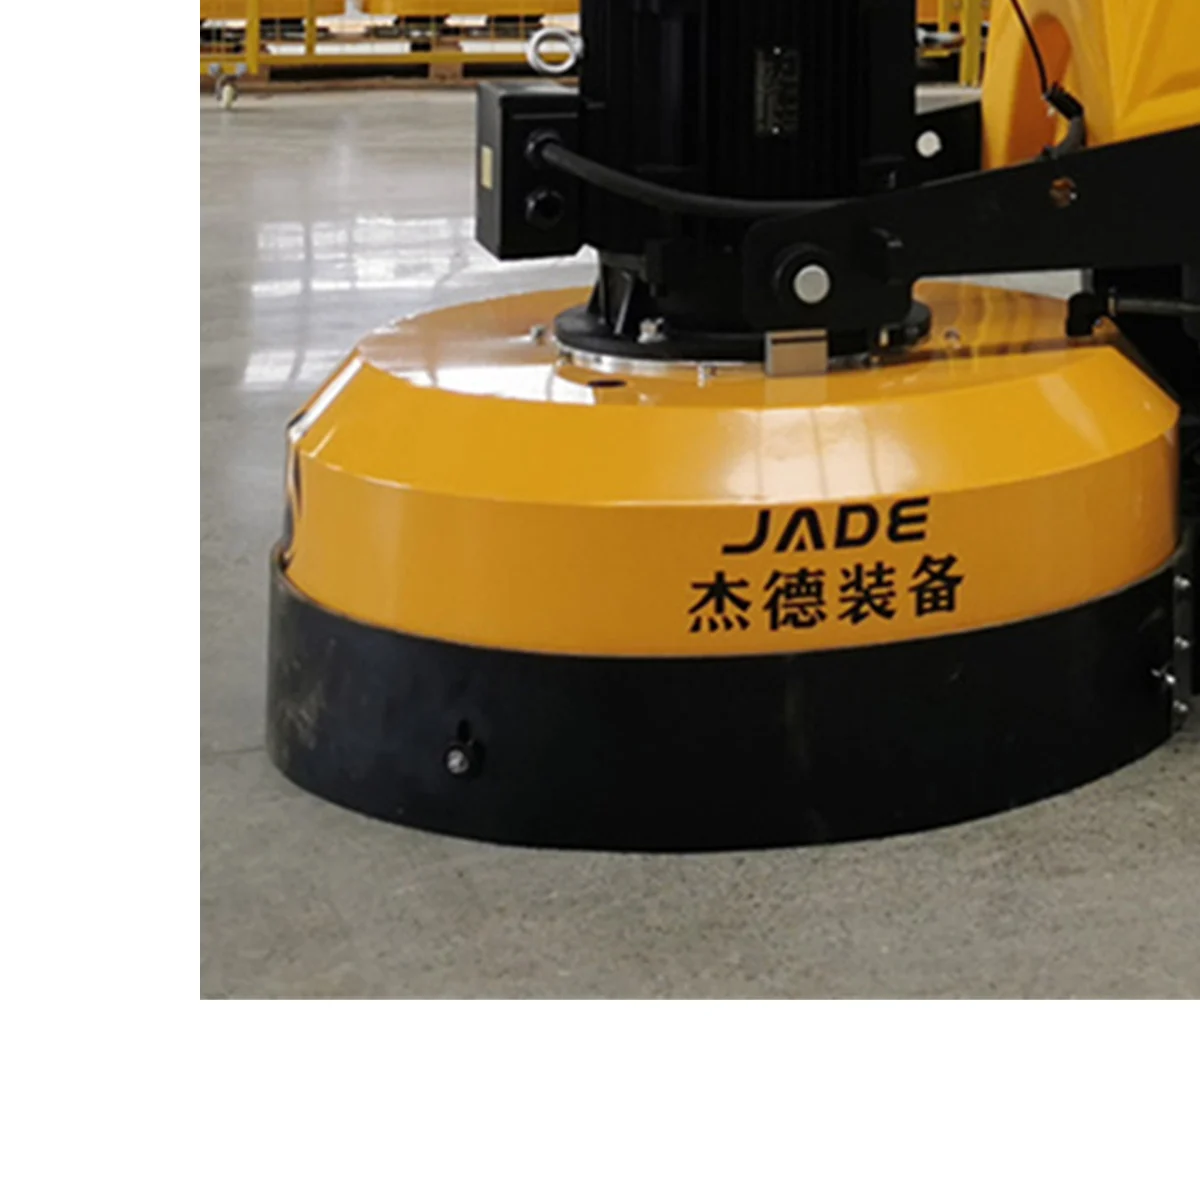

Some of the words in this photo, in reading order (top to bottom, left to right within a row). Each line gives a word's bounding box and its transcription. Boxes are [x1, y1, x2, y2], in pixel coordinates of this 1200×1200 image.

[721, 496, 931, 555] JADE
[688, 553, 965, 633] 杰德装备
